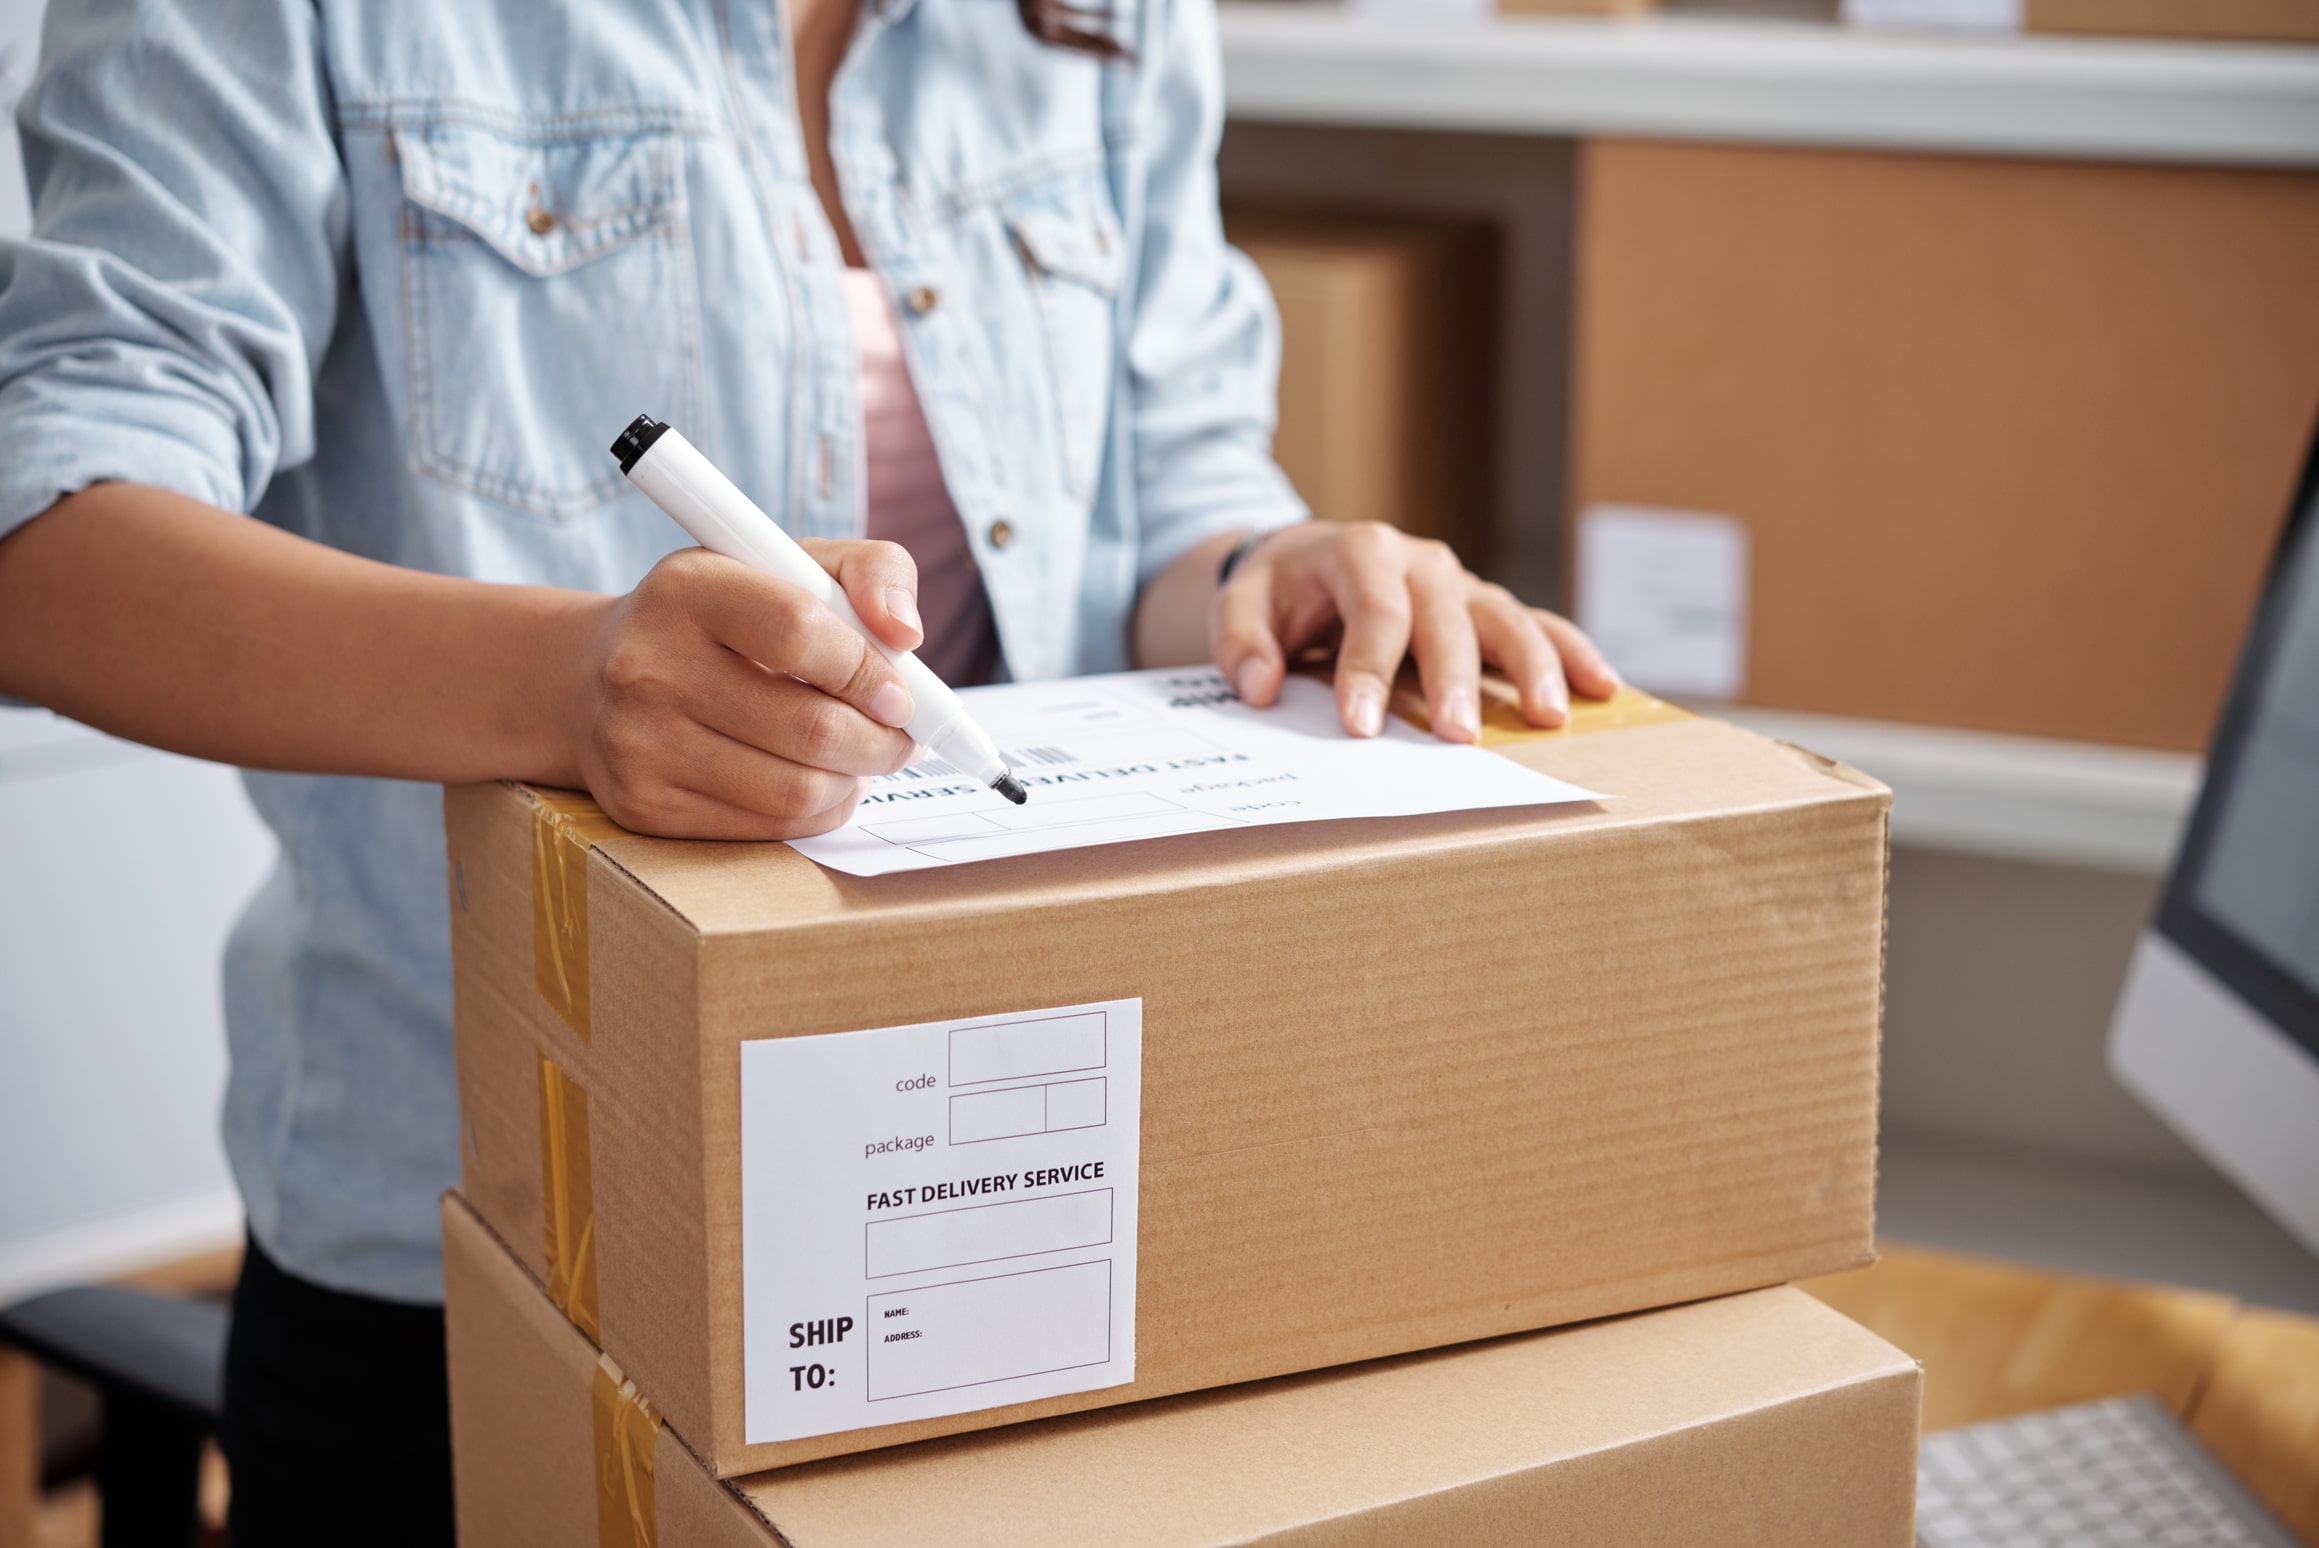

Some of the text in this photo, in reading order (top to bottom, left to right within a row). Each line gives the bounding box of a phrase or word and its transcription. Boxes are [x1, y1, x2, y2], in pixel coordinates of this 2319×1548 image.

[860, 754, 1248, 805] FAST DELIVE SERVI
[895, 1073, 936, 1092] code
[865, 1133, 935, 1159] package
[867, 1161, 1105, 1211] FAST DELIVERY SERVICE
[884, 1307, 910, 1319] NAME:
[789, 1316, 854, 1349] SHIP
[884, 1329, 923, 1344] ADDRESS:
[789, 1363, 835, 1392] TO:
